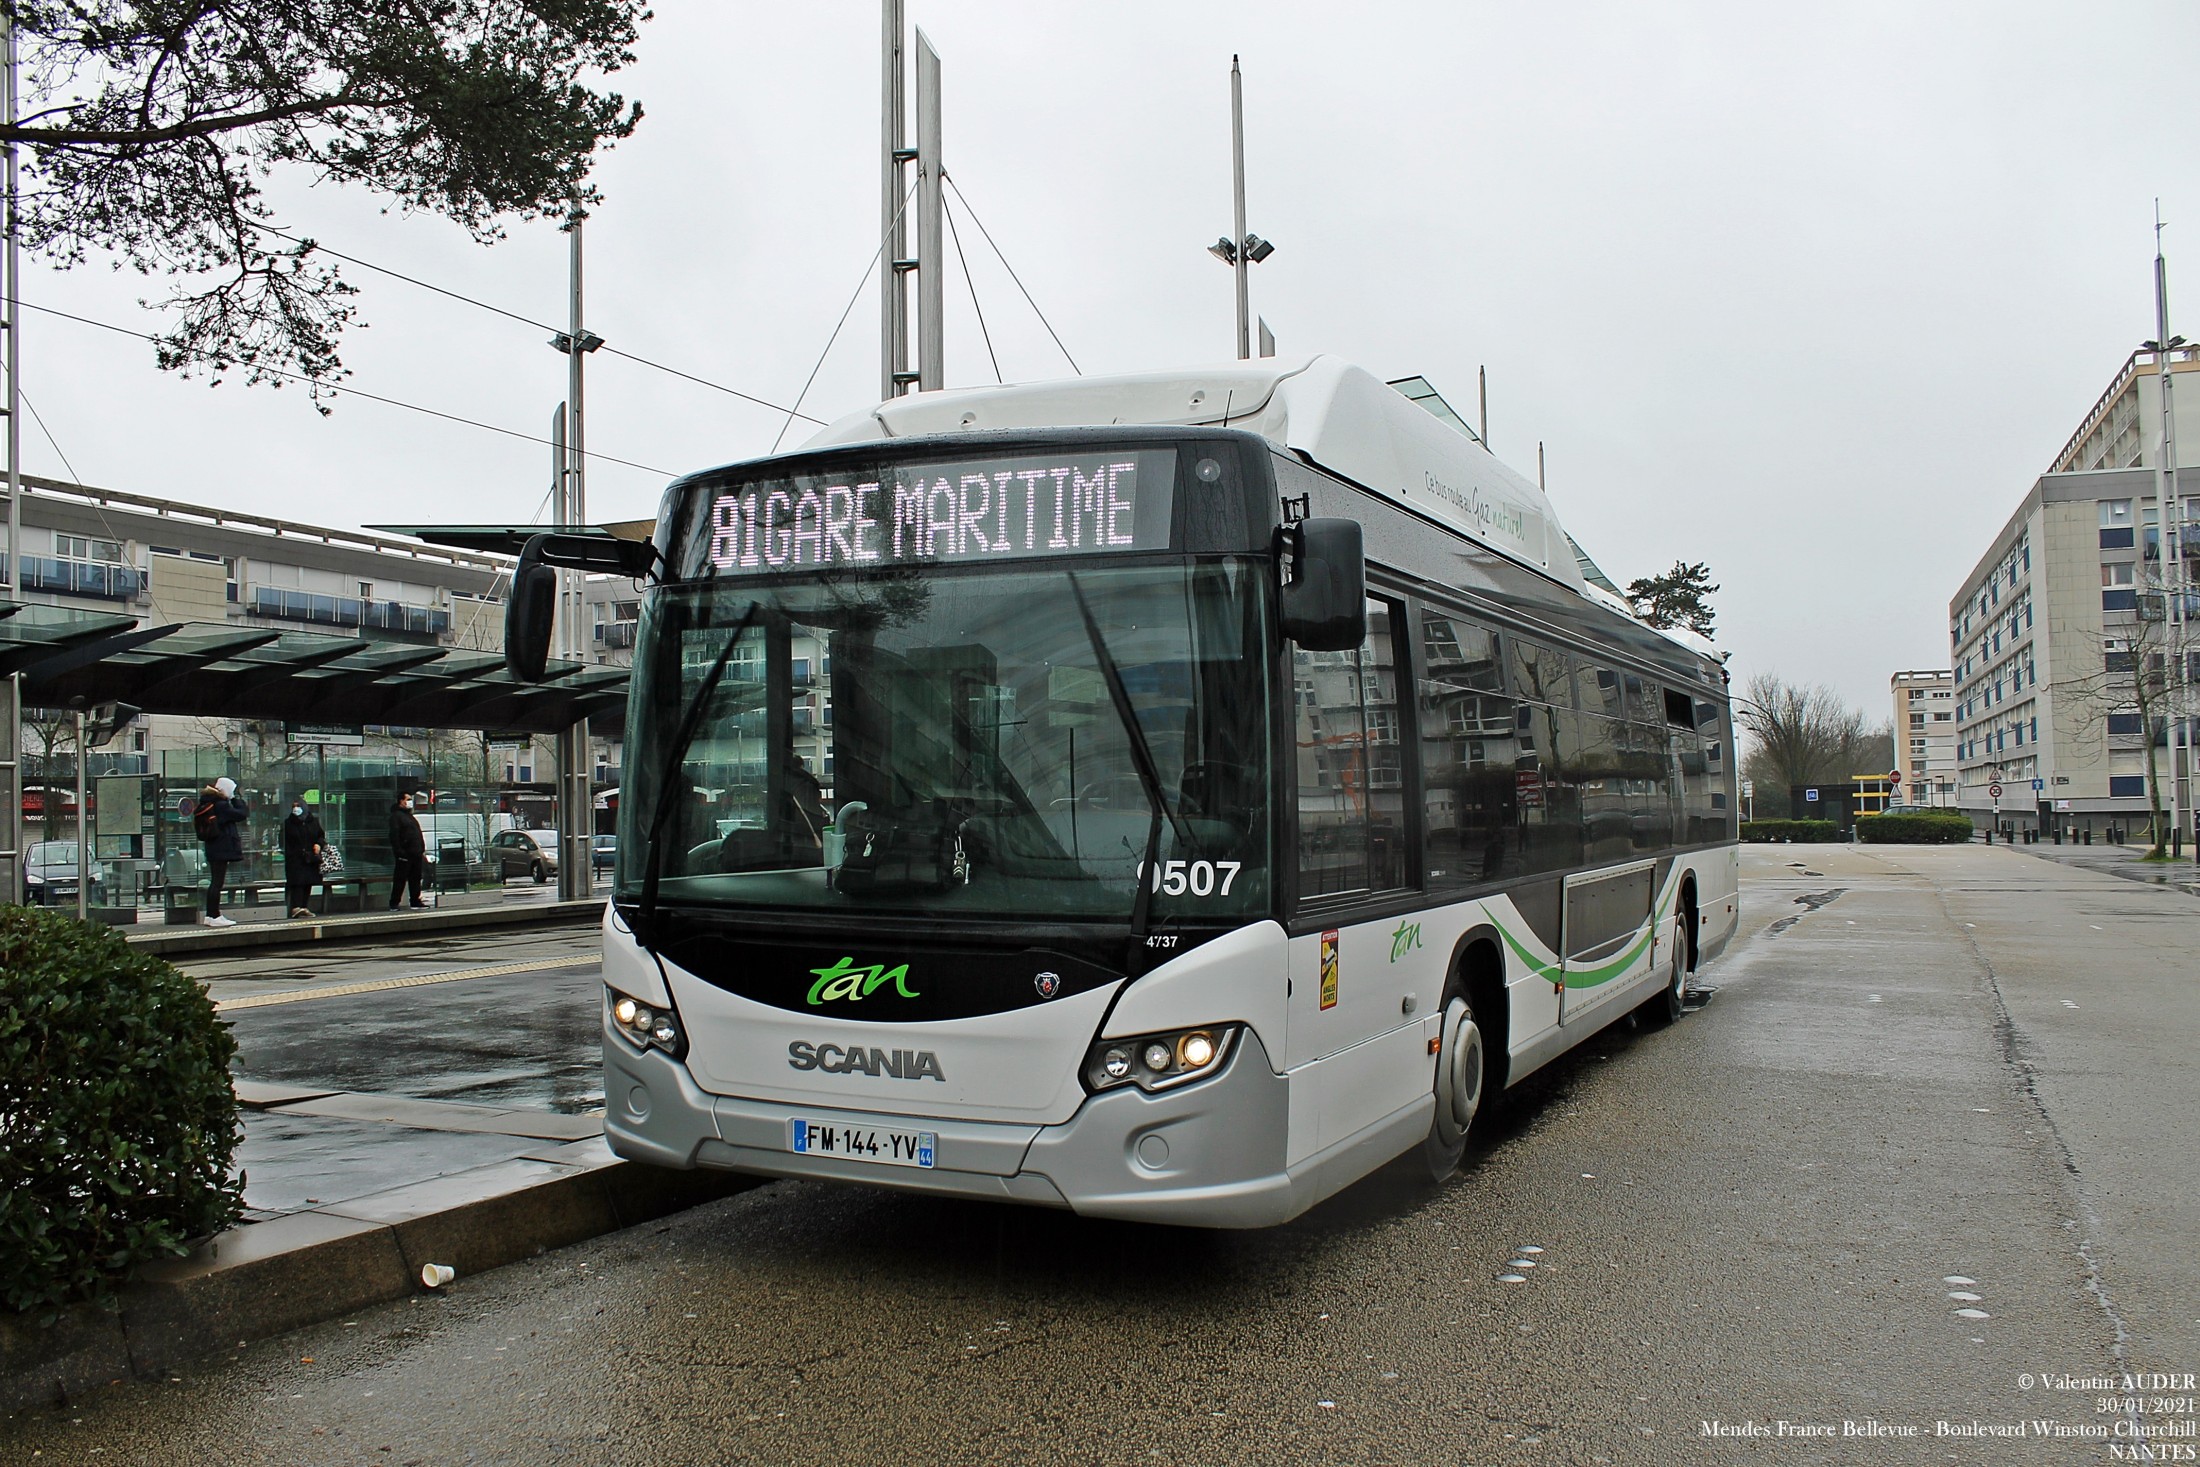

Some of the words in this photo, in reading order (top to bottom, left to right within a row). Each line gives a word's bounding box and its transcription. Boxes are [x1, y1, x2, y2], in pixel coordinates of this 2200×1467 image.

[764, 482, 880, 565] GARE
[893, 462, 1136, 559] MARITIME
[1435, 474, 1447, 500] bus
[1472, 486, 1490, 526] Gaz
[1146, 935, 1178, 948] 4737
[1390, 920, 1423, 963] tan
[807, 956, 921, 1006] tan
[788, 1040, 946, 1082] SCANIA
[920, 1151, 932, 1164] 44
